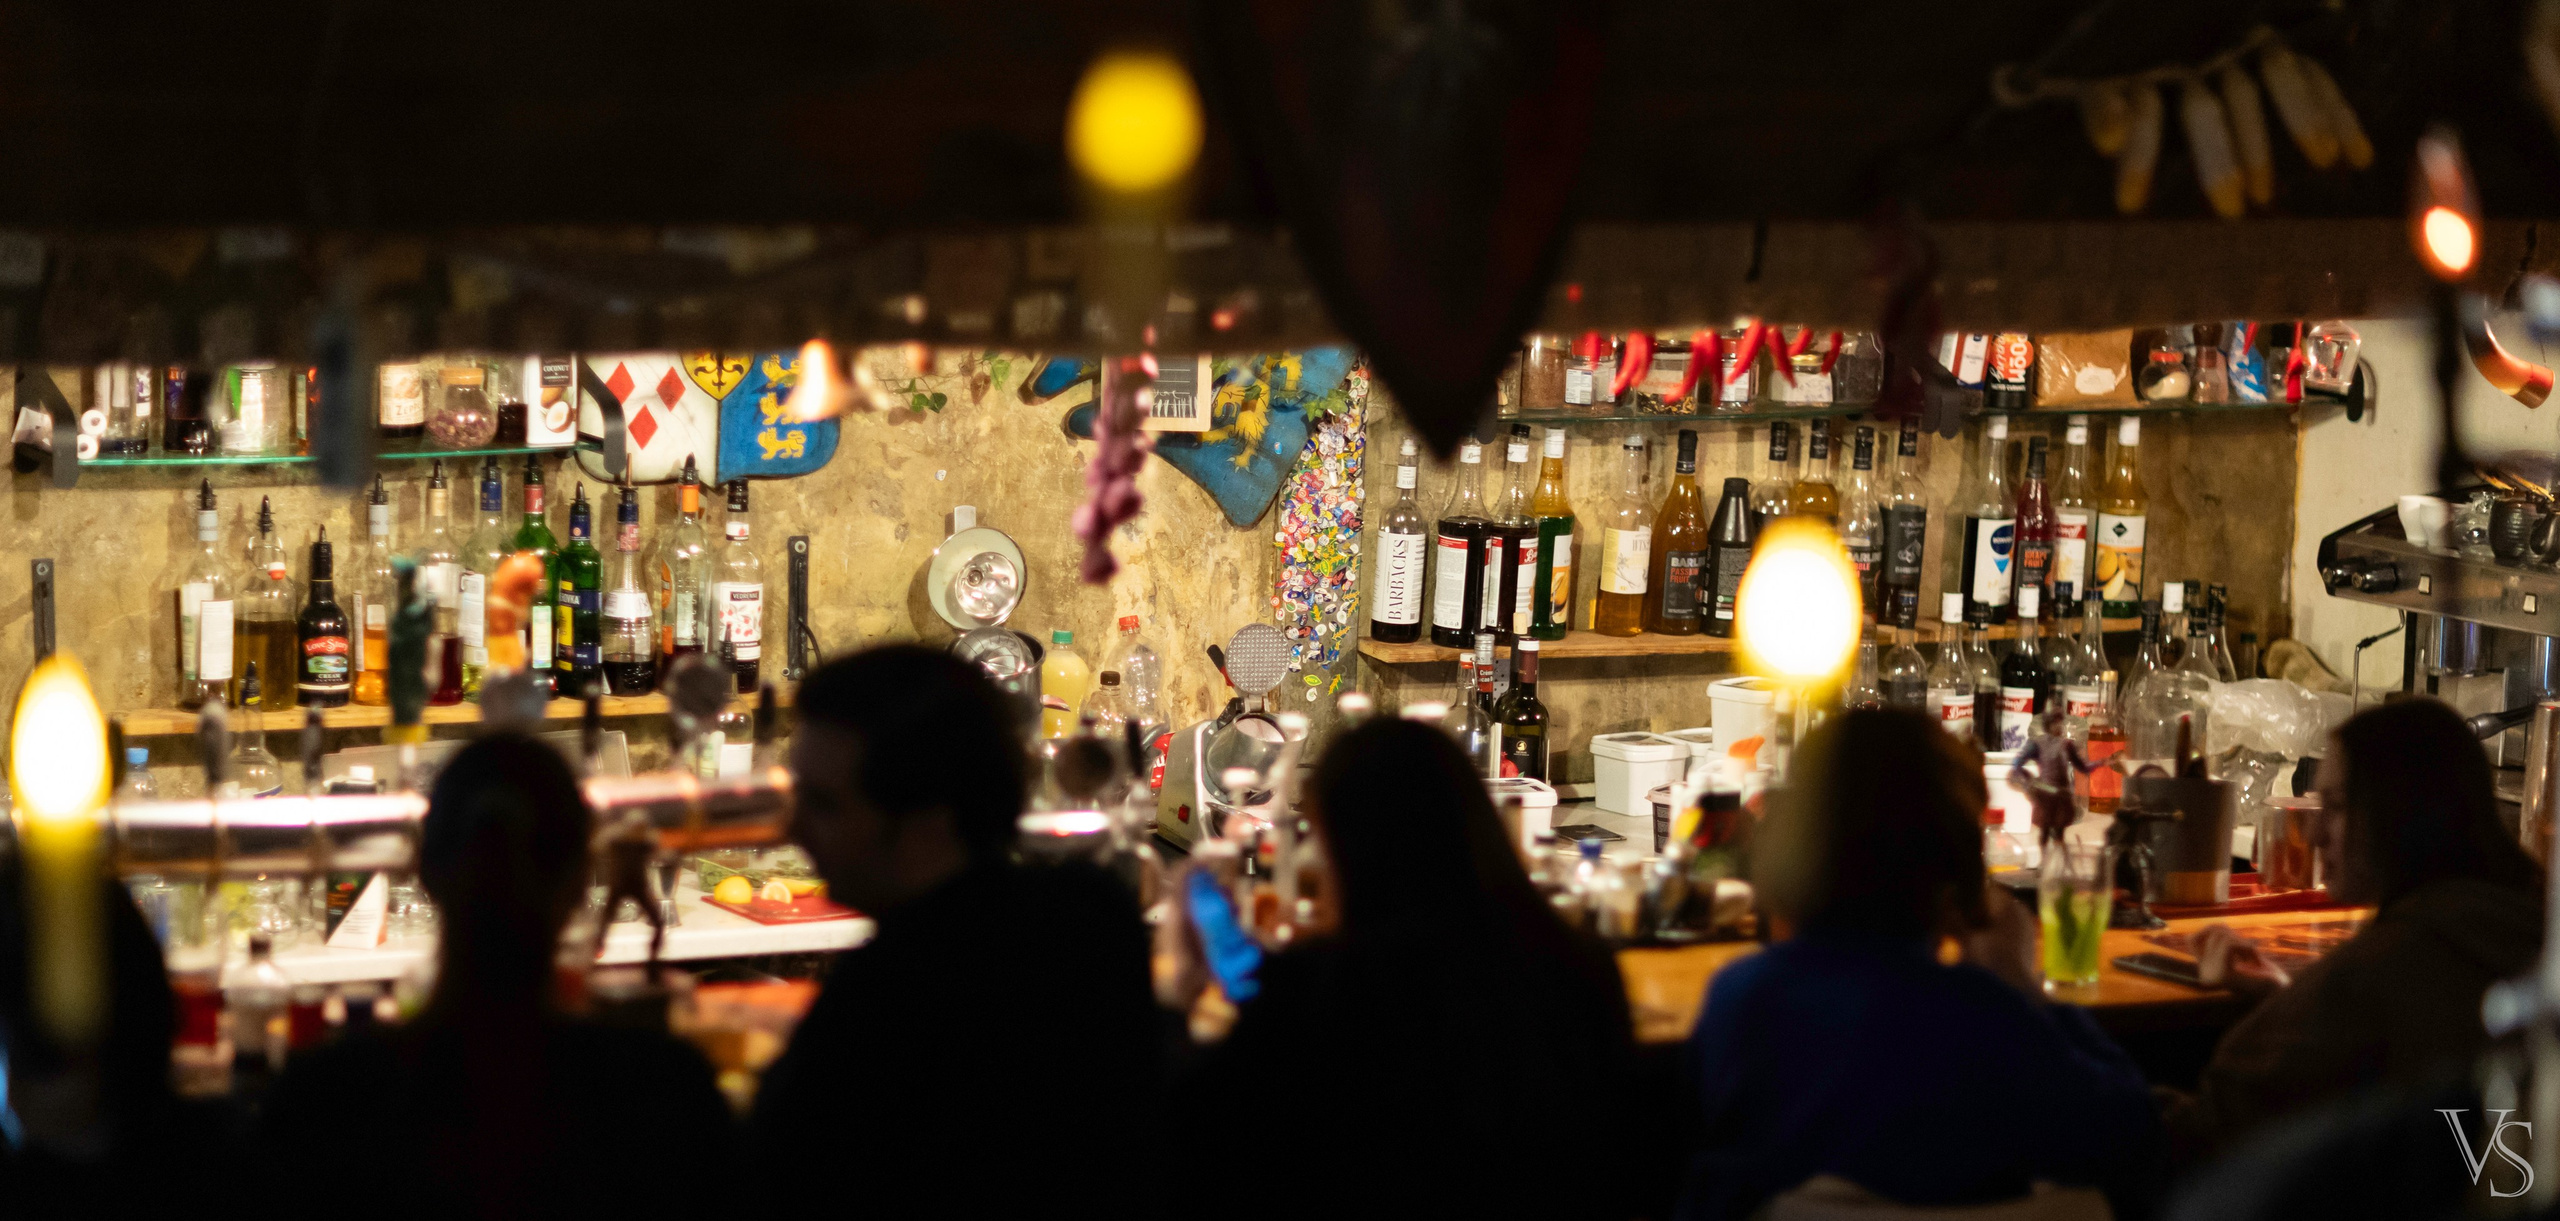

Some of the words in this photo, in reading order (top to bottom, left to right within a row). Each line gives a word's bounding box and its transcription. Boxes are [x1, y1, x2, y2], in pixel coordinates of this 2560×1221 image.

[543, 364, 570, 372] COCONUT
[2024, 559, 2043, 568] FRUIT
[1670, 568, 1699, 576] PASSION
[1387, 539, 1407, 621] BARBACKS
[1669, 575, 1690, 583] FRUIT
[305, 641, 326, 652] Love
[325, 638, 348, 652] Story
